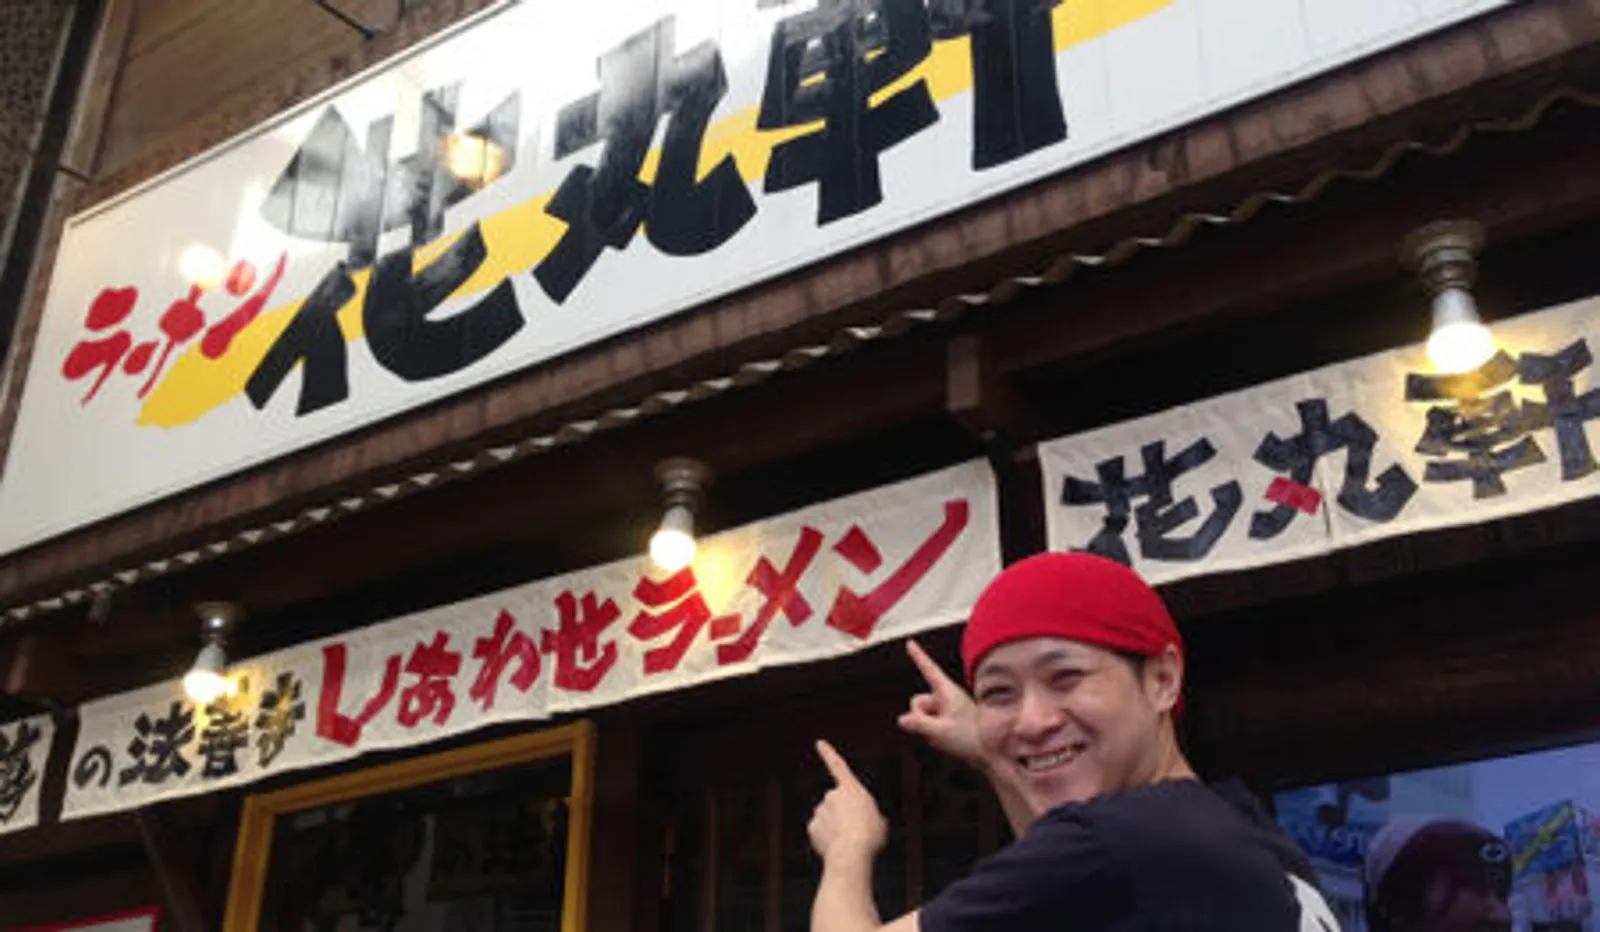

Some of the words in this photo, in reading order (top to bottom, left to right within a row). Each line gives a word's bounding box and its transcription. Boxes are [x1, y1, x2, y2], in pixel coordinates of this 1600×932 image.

[245, 0, 1068, 415] 花丸軒
[62, 250, 288, 406] ラーメン
[1061, 337, 1600, 564] 花丸軒
[315, 498, 970, 748] しあわせラーメン
